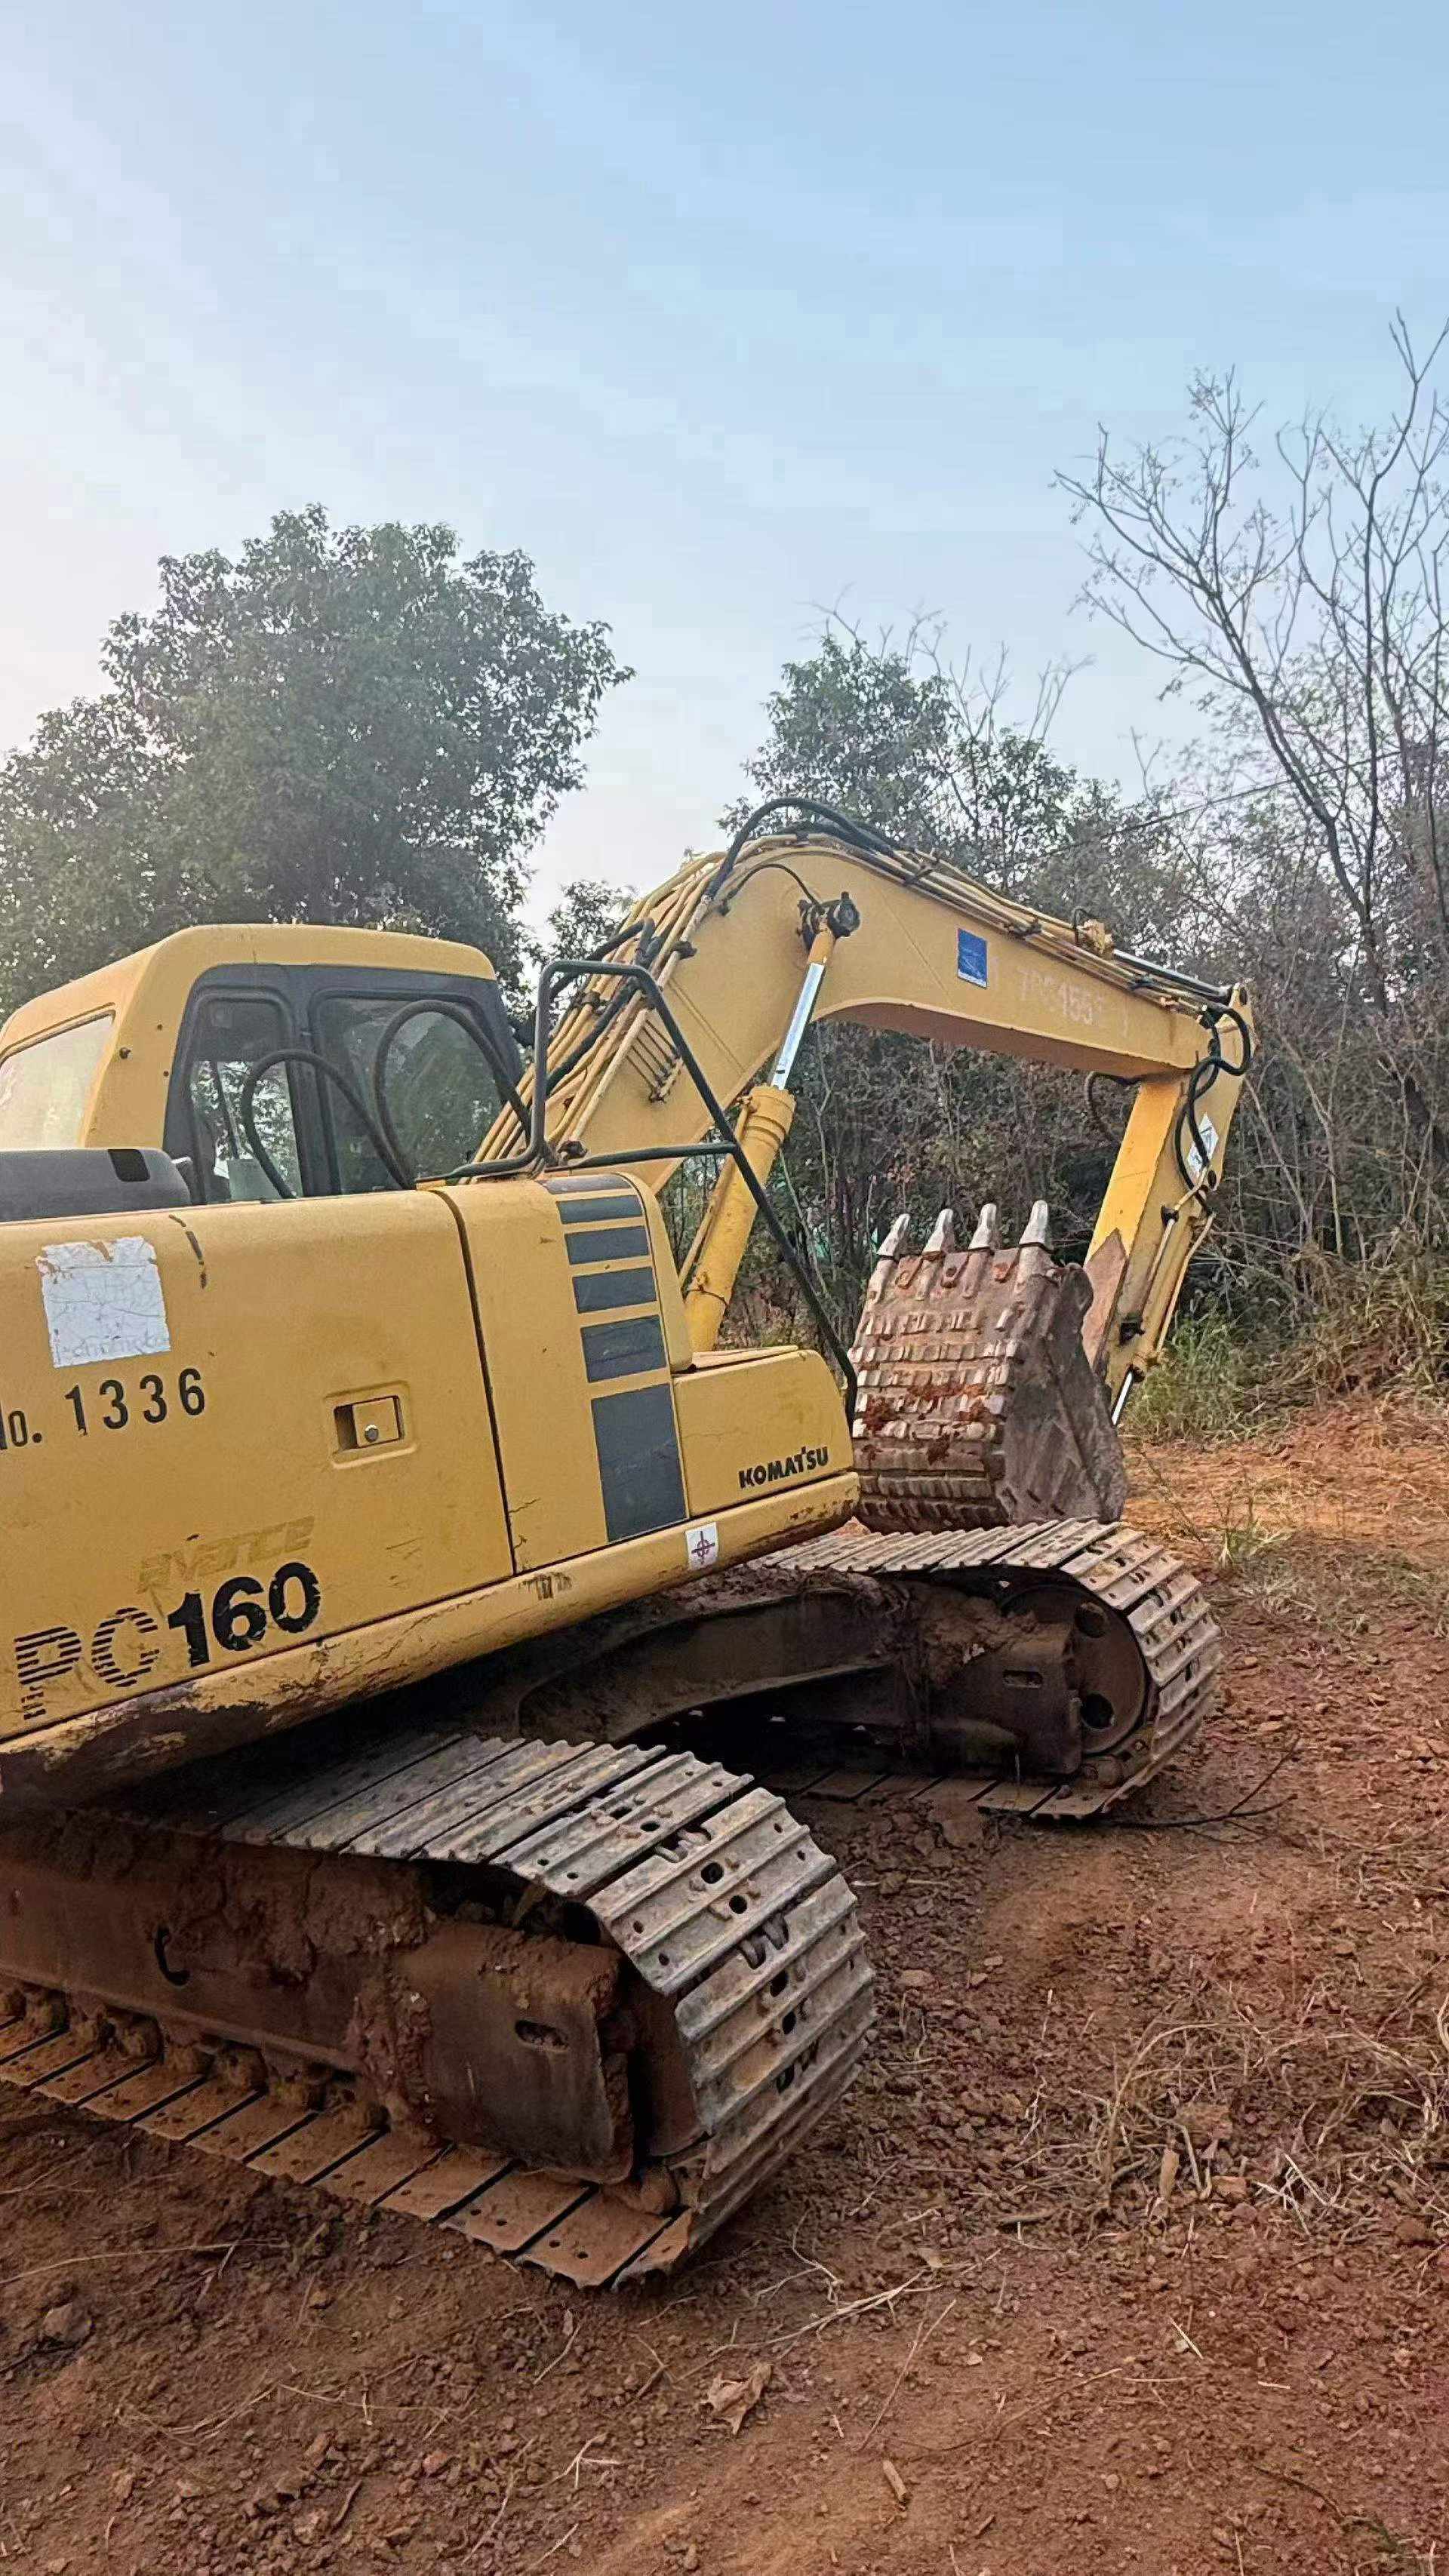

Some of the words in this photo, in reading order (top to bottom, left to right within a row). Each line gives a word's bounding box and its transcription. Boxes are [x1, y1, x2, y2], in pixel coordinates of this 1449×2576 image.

[64, 1368, 205, 1437] 1336
[738, 1446, 829, 1489] KOMATSU
[14, 1562, 321, 1720] PC160
